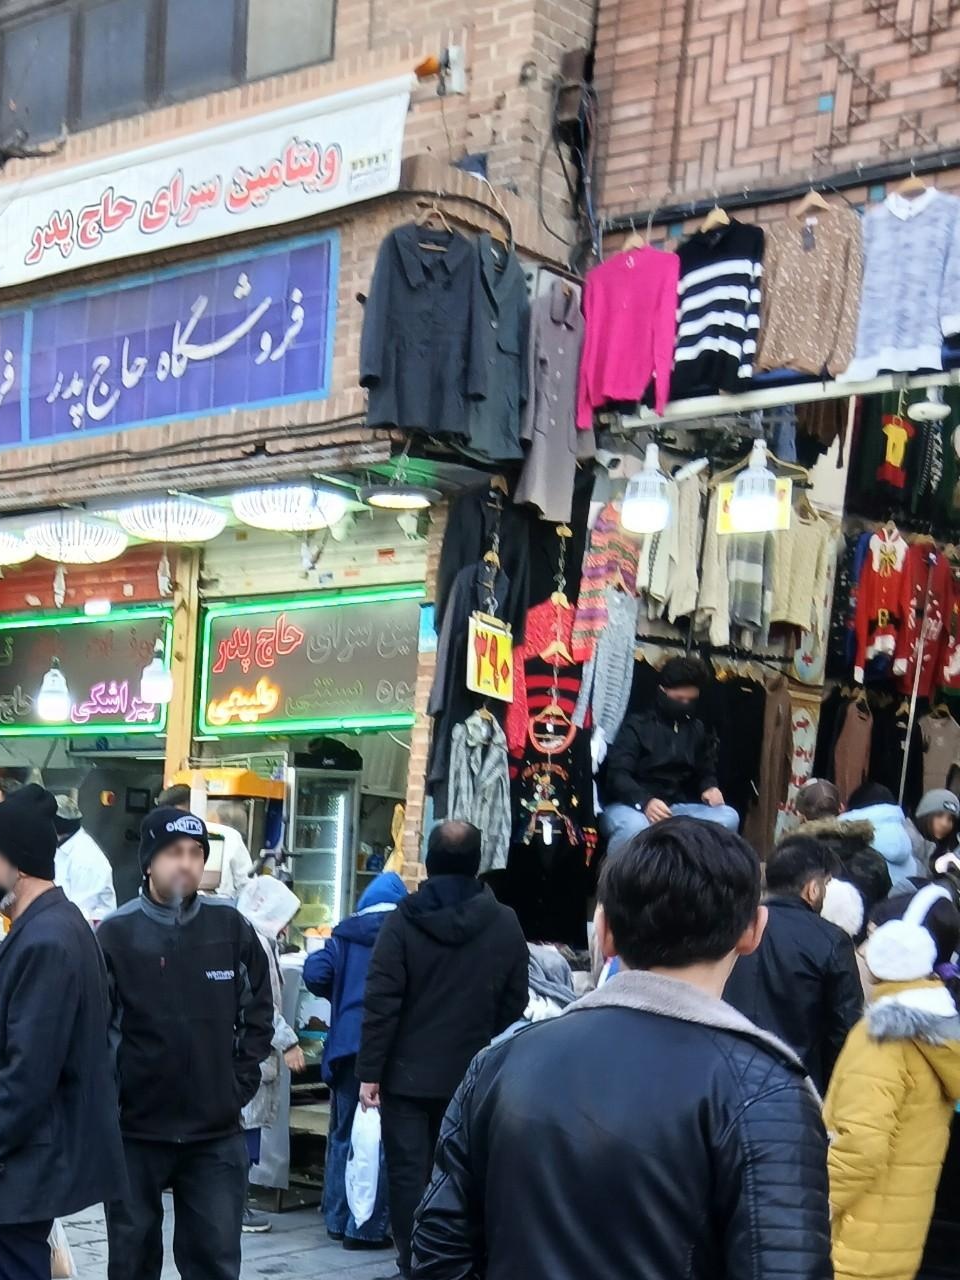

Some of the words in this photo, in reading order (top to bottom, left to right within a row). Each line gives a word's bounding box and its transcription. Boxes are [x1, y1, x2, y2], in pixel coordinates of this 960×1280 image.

[139, 168, 222, 235] سرای
[226, 136, 342, 213] ویتامین
[24, 208, 74, 264] پدر
[76, 185, 137, 249] حاج
[155, 272, 305, 383] فروشگاه
[46, 371, 86, 429] پدر
[86, 336, 149, 421] حاج
[212, 626, 252, 674] پدر
[255, 611, 304, 667] حاج
